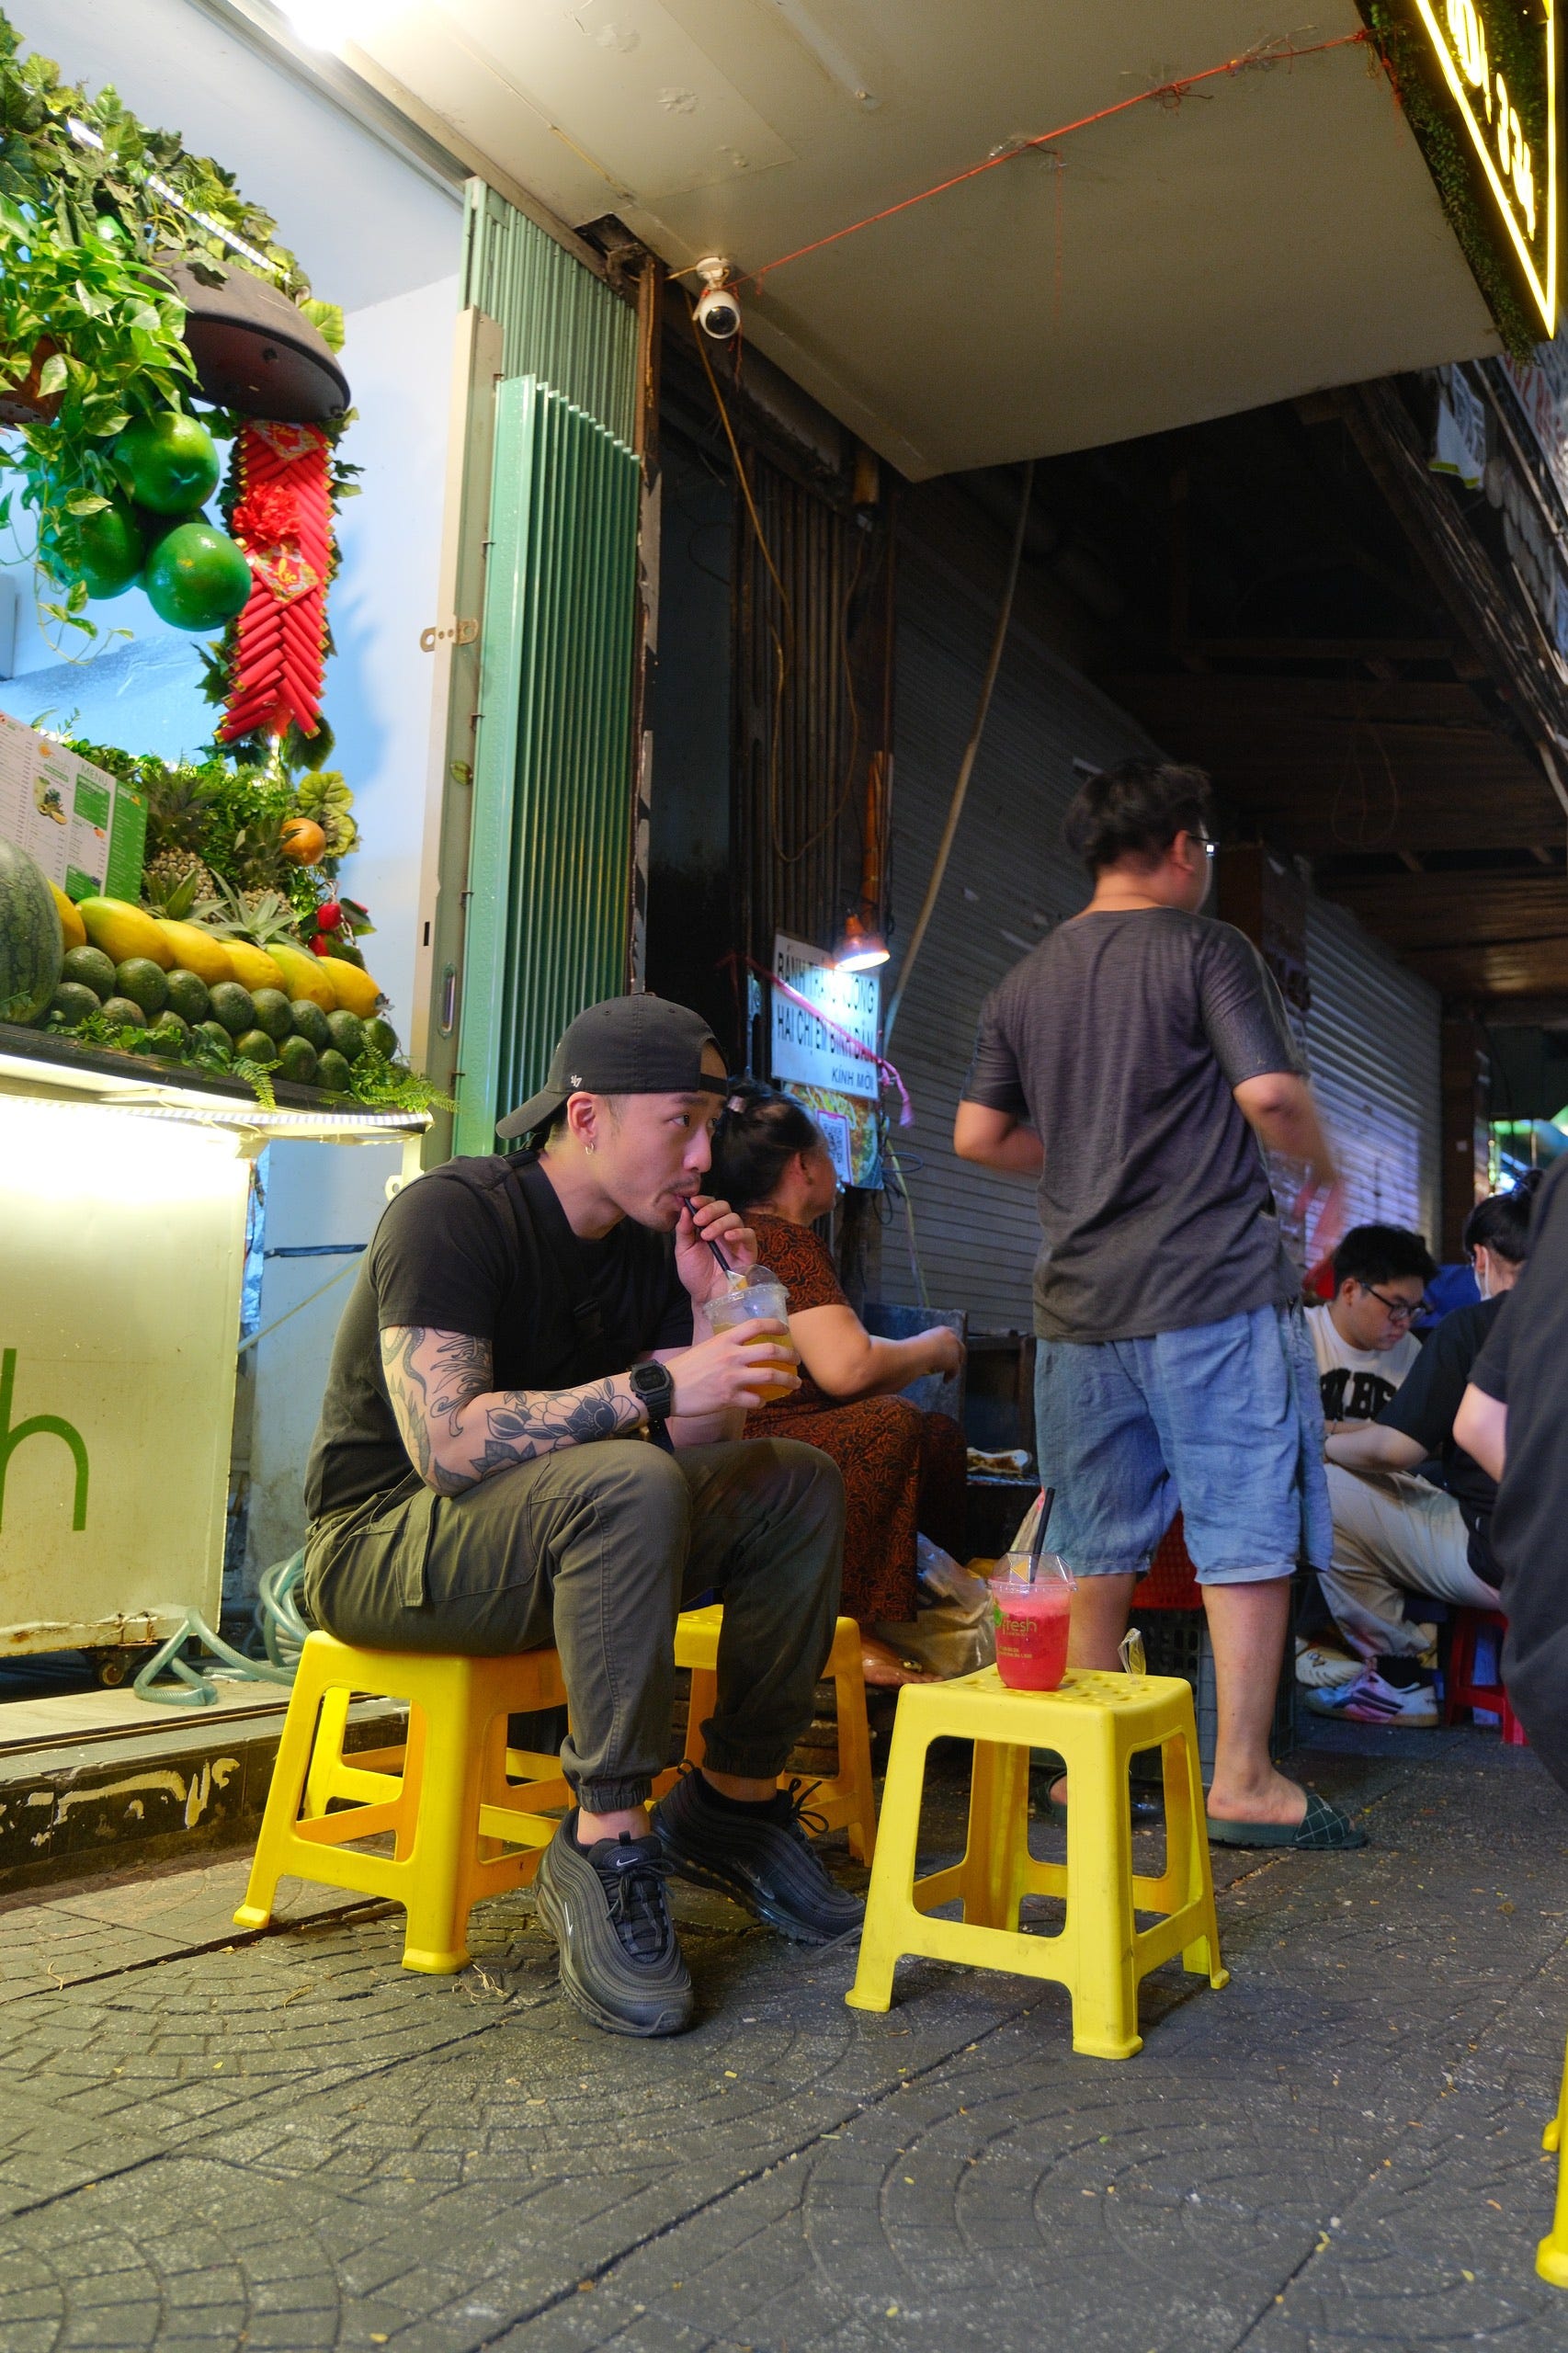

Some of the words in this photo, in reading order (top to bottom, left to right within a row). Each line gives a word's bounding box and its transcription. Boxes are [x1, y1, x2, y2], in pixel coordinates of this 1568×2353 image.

[81, 763, 108, 787] MENU
[777, 1004, 794, 1043] HAI
[832, 1064, 855, 1086] KÍNH
[1003, 1615, 1038, 1635] fresh
